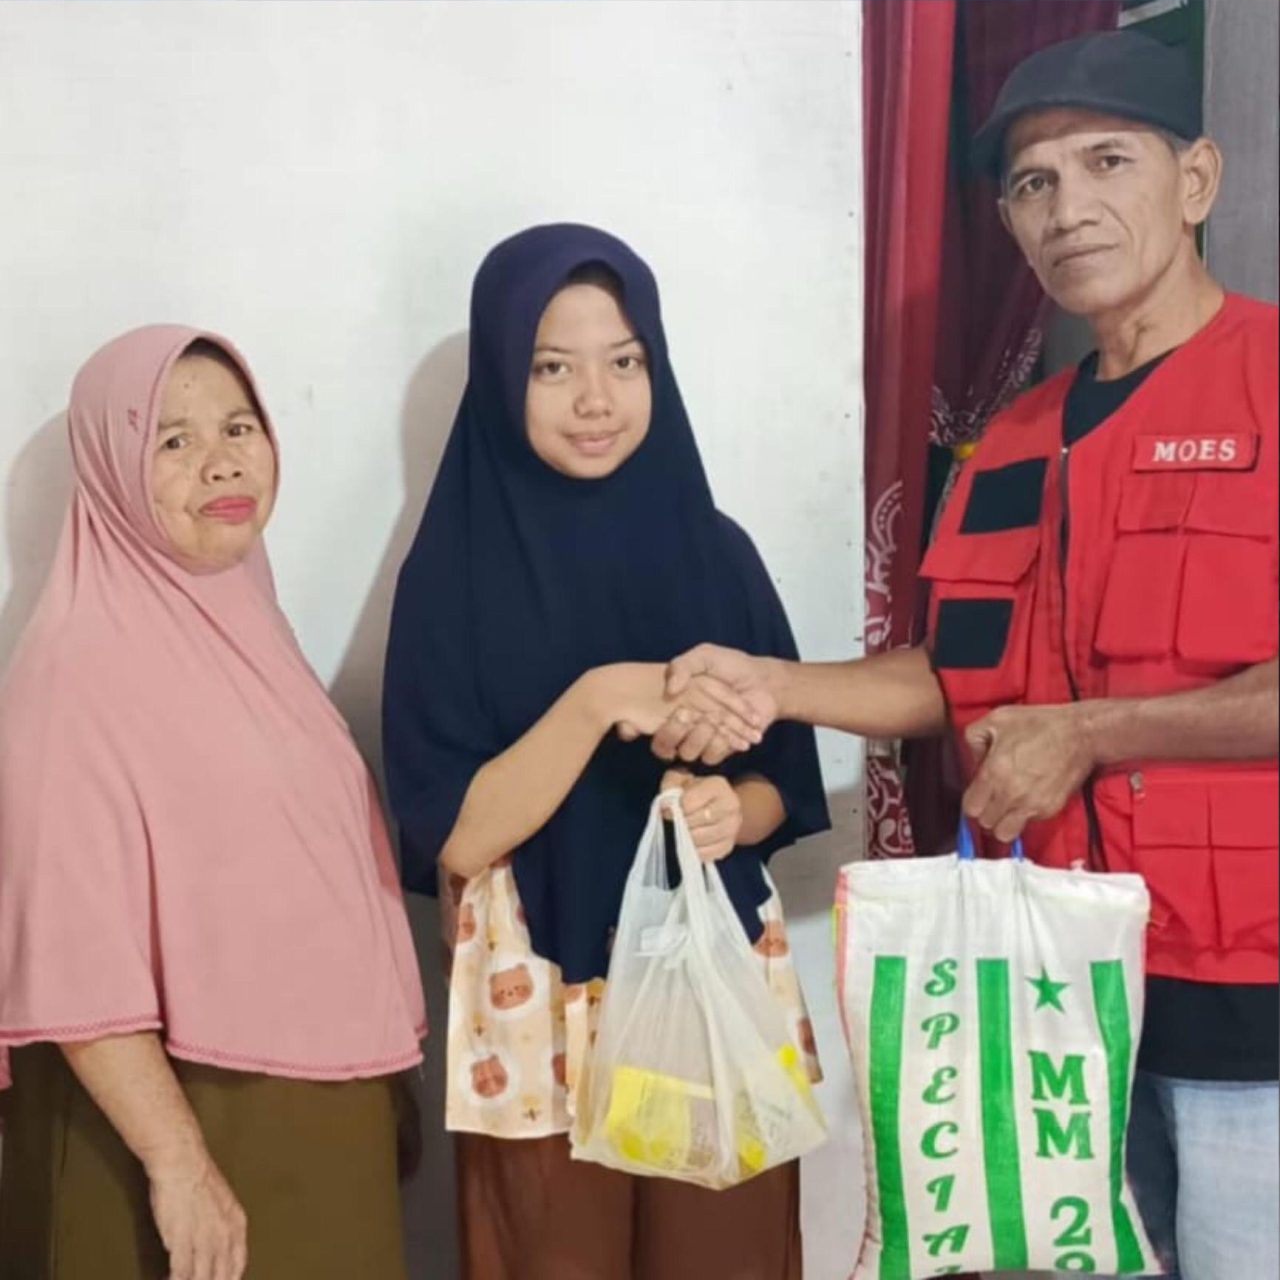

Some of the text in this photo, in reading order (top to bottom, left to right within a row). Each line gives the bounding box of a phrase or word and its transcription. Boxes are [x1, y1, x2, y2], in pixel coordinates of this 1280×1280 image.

[1152, 439, 1236, 462] MOES
[920, 958, 970, 1273] SPECIA
[1028, 1050, 1094, 1160] MM
